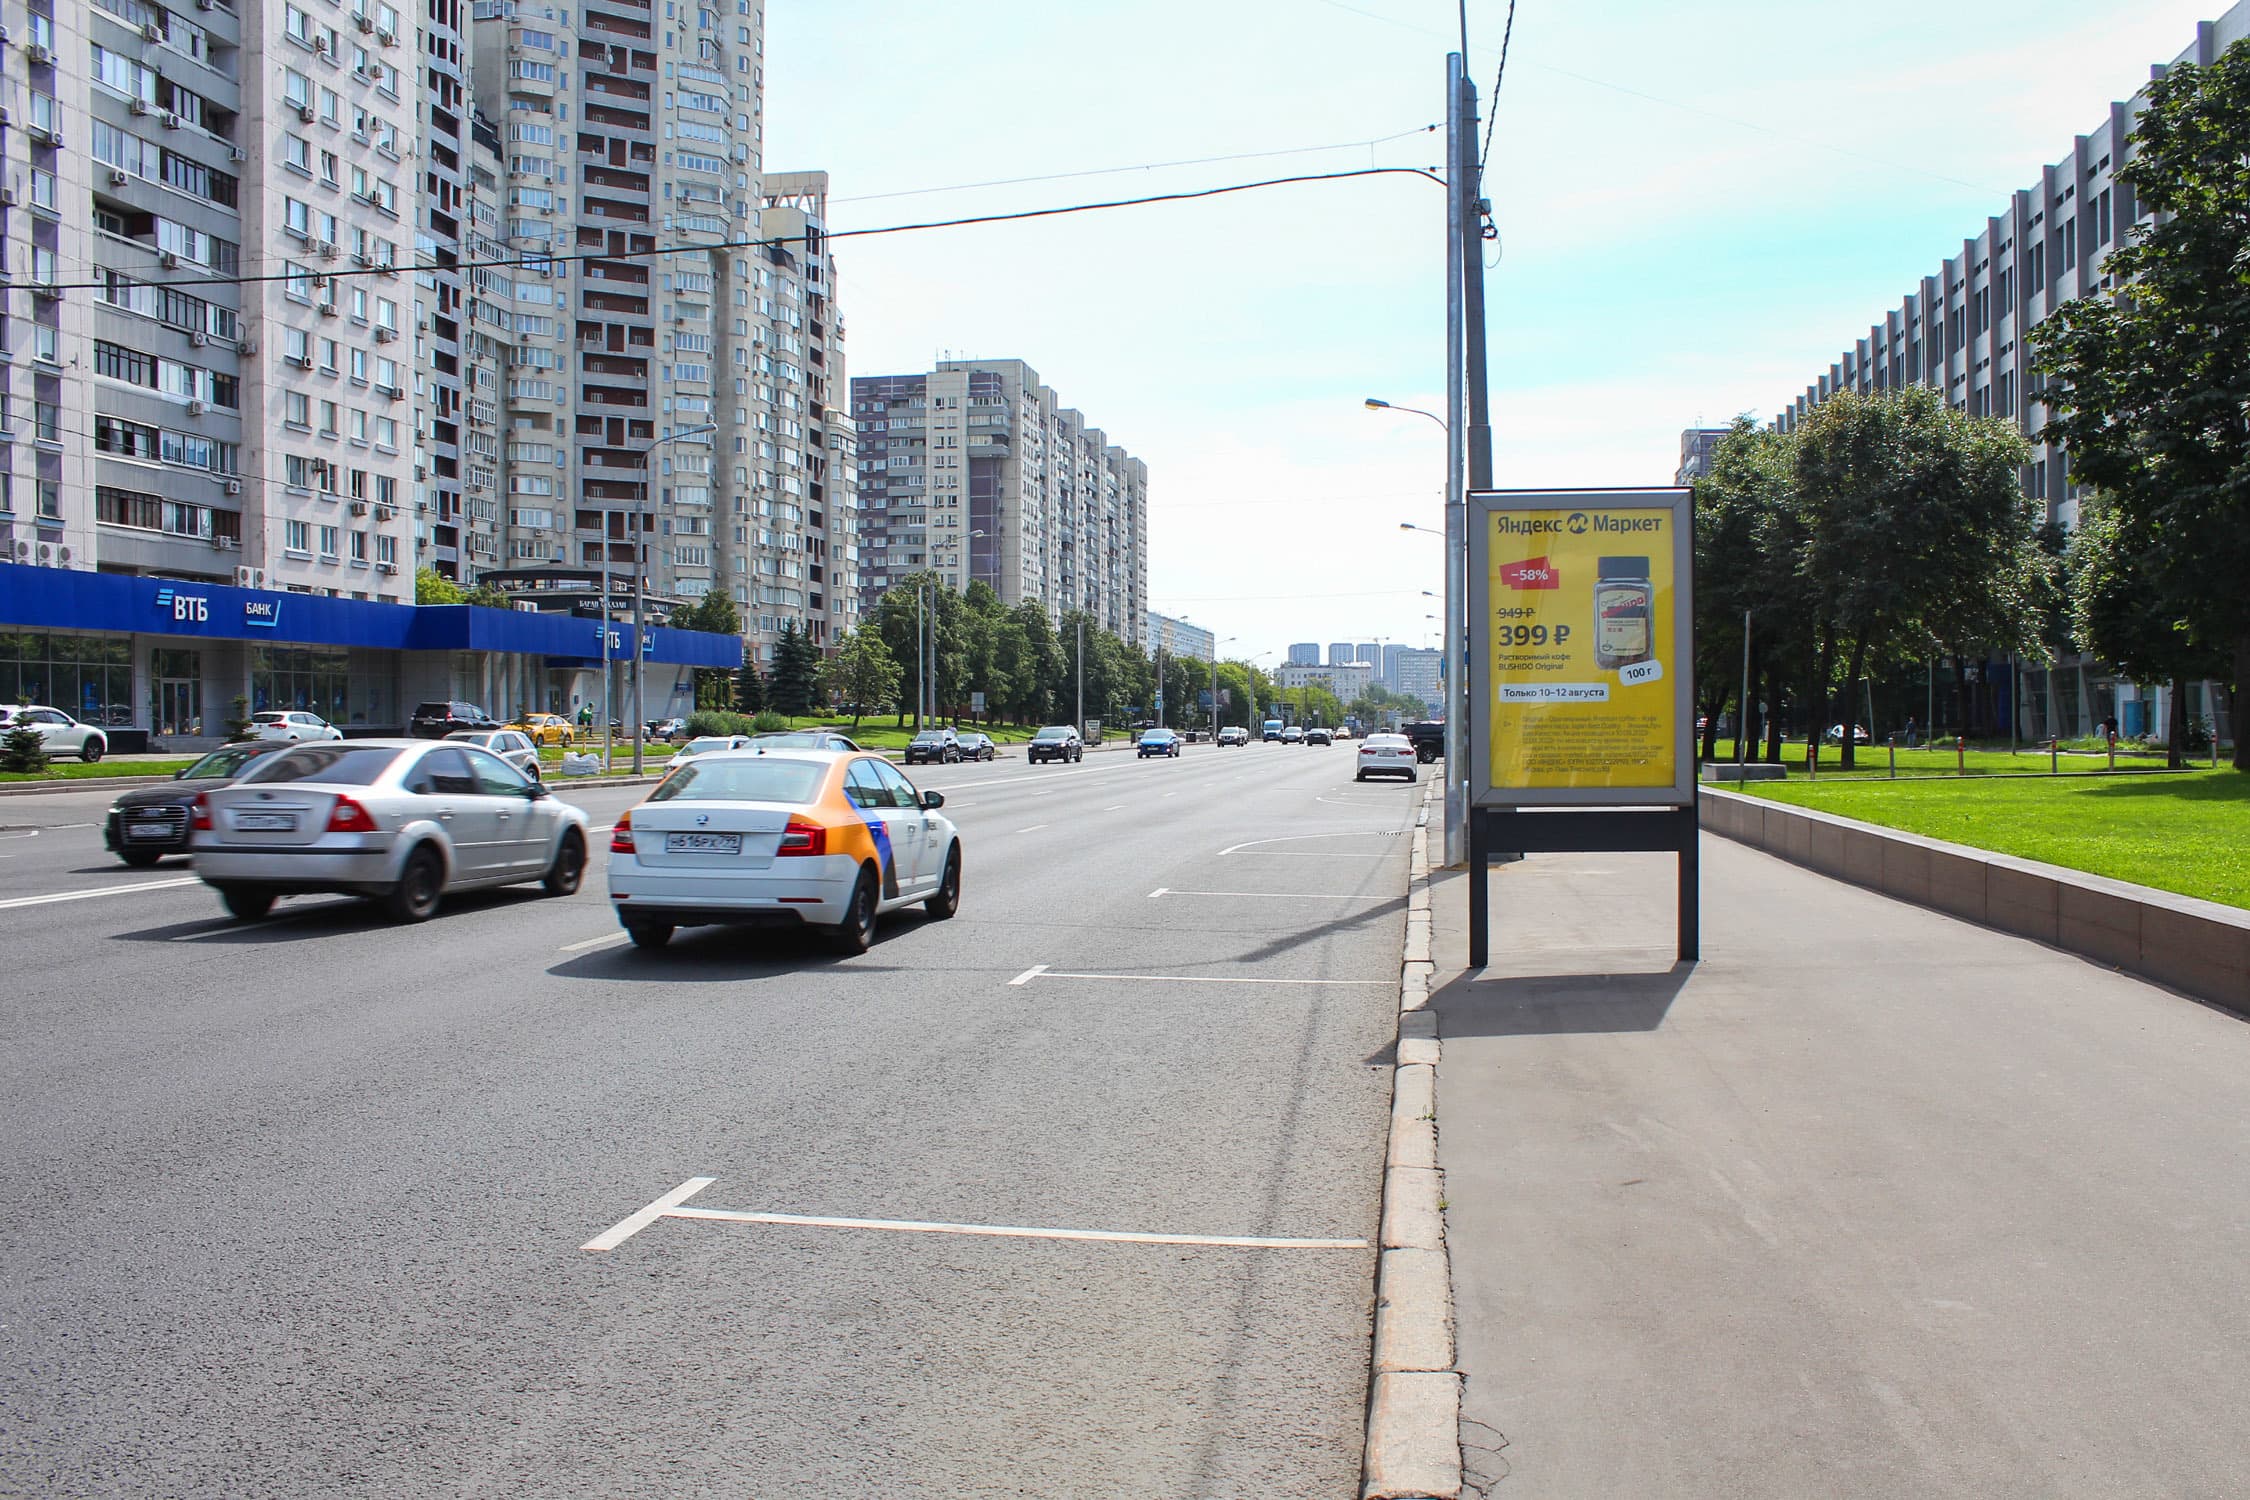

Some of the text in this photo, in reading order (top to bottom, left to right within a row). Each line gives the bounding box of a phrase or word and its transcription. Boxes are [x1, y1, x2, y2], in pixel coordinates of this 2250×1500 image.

[1497, 515, 1662, 535] Яндекс Маркет
[1511, 569, 1548, 581] -58%
[174, 595, 271, 621] ВТБ БАНК
[1498, 607, 1523, 619] 949
[608, 631, 620, 649] ТБ
[1498, 624, 1548, 646] 399
[1551, 653, 1572, 662] кофе
[1498, 662, 1564, 672] BUSHIDO Original
[1626, 667, 1645, 680] 100
[1504, 688, 1537, 697] Только
[1568, 689, 1605, 698] августа
